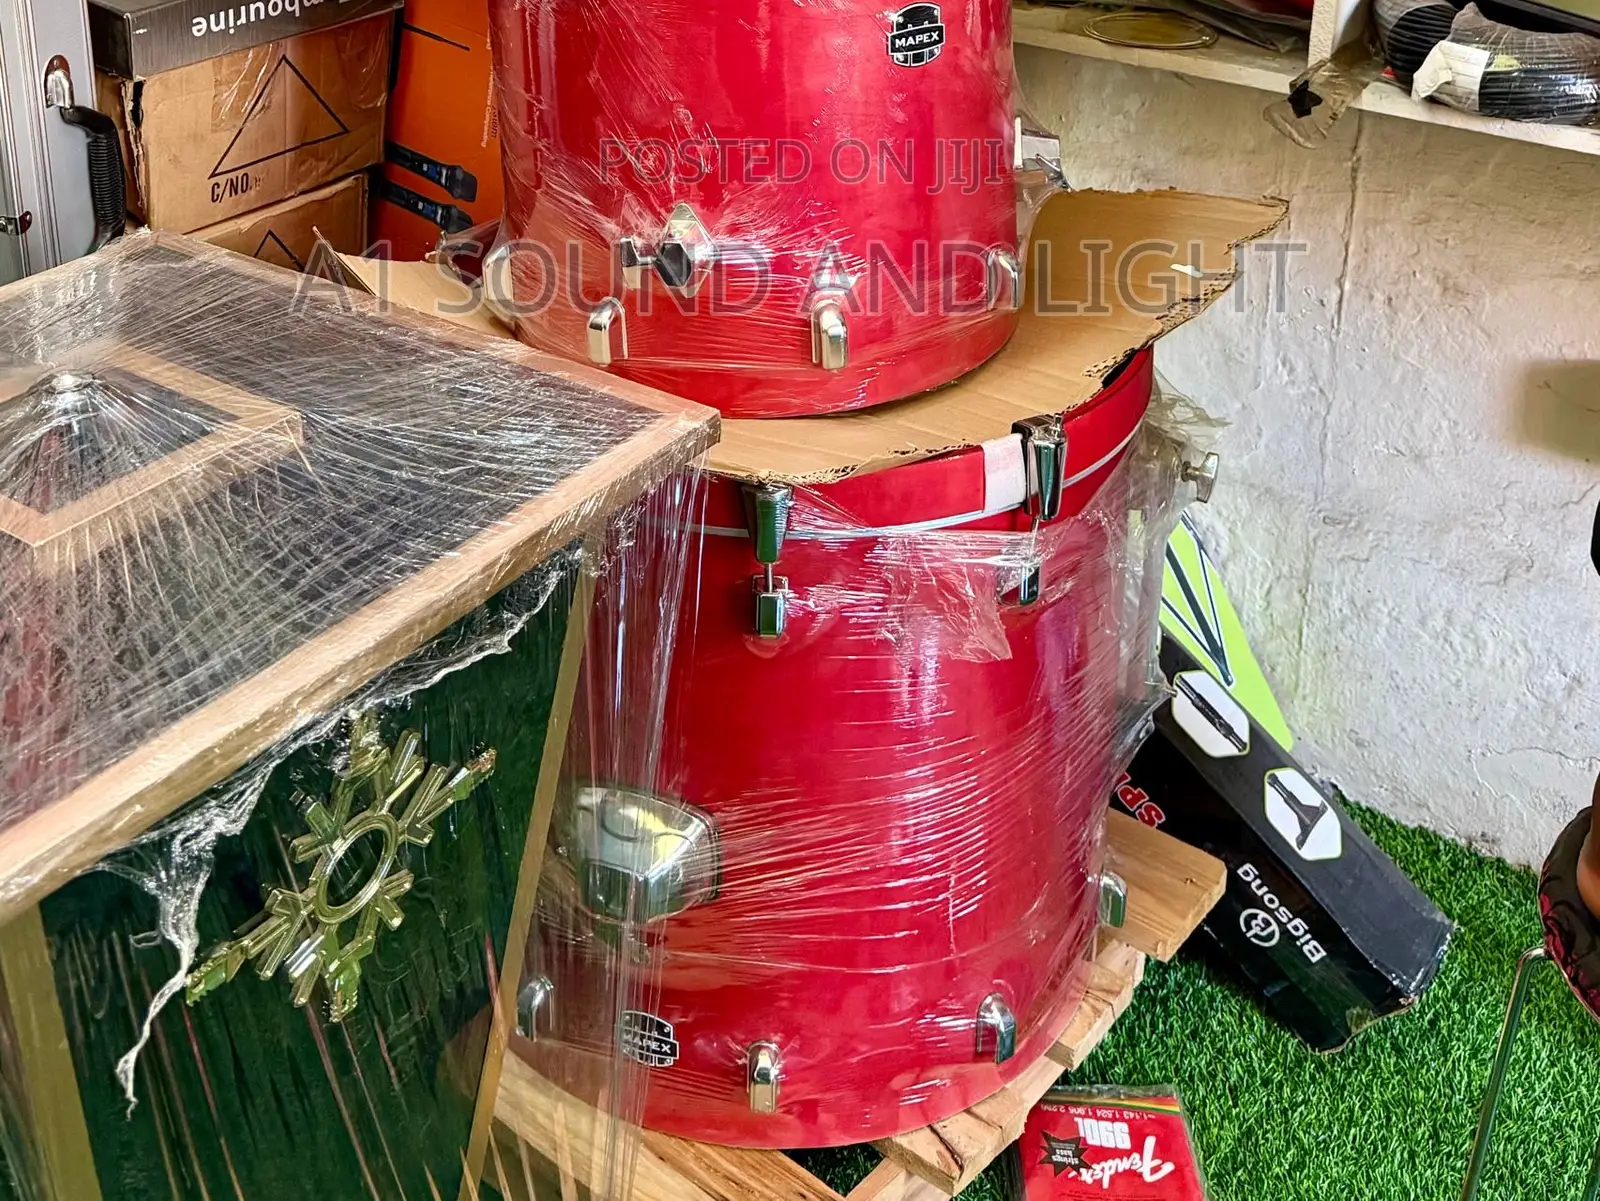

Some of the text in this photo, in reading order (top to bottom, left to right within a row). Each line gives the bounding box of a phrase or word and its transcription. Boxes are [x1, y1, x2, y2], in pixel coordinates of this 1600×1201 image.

[895, 29, 939, 47] MAPEX
[211, 173, 252, 203] C/NO.
[1237, 862, 1328, 964] Bigsong
[1096, 1109, 1120, 1118] 1.524
[1074, 1117, 1131, 1149] 990L
[1052, 1155, 1079, 1165] strings
[1068, 1136, 1175, 1189] Fender
